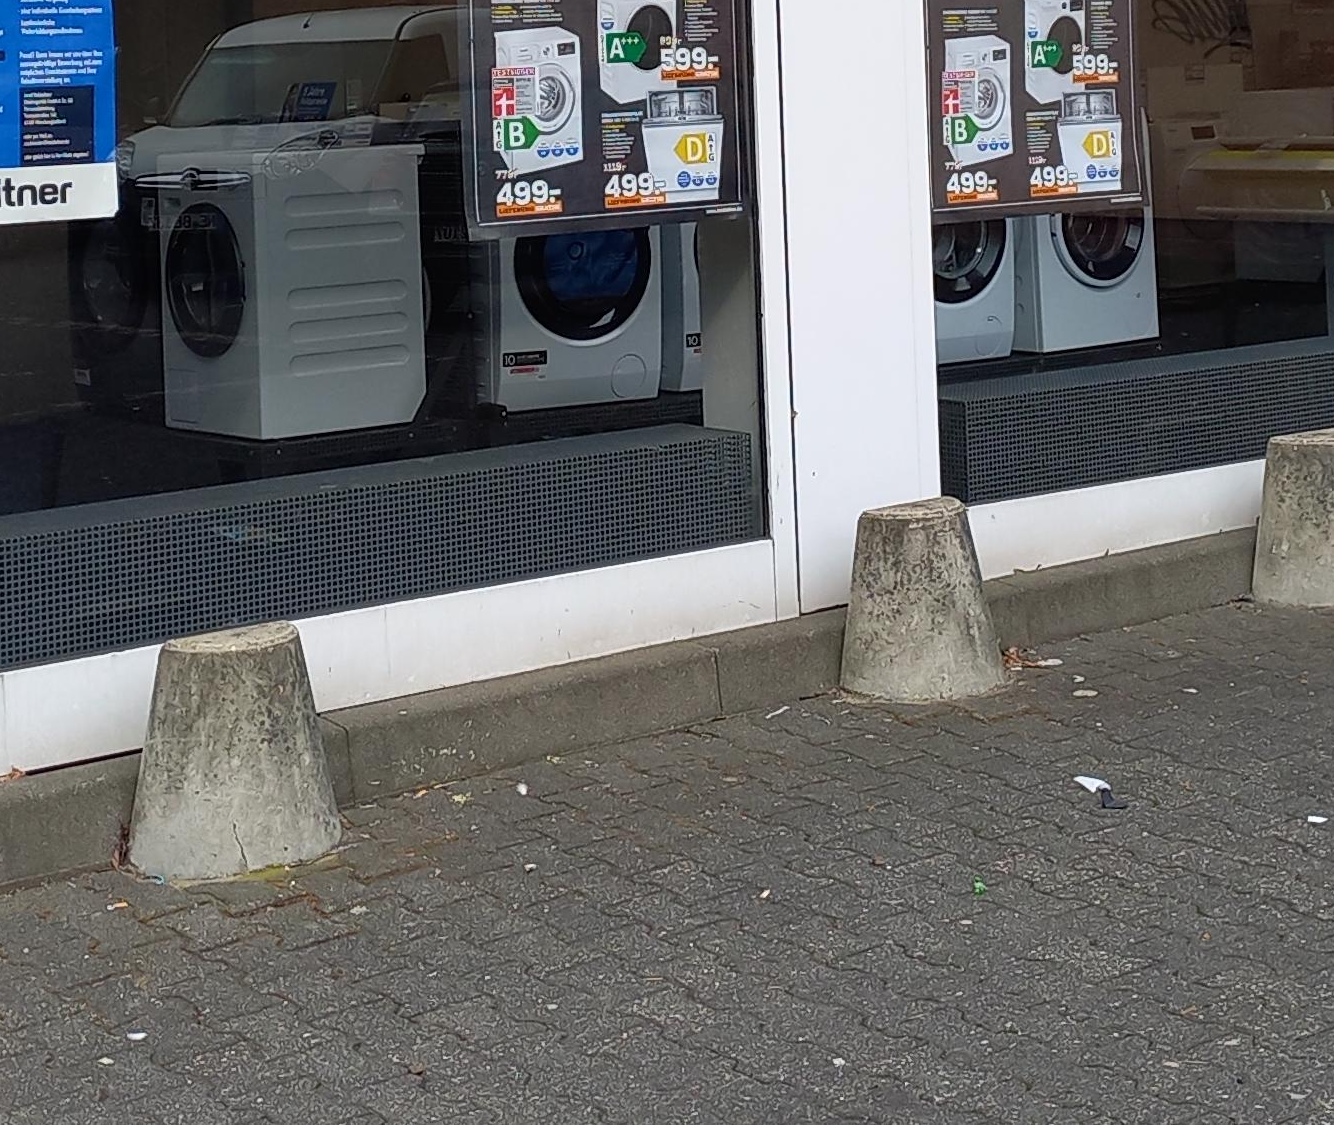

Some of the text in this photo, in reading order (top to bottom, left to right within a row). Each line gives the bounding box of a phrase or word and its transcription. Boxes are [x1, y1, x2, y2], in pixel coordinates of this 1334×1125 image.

[509, 122, 525, 147] B
[954, 120, 967, 142] B
[686, 137, 703, 161] D
[1092, 134, 1106, 156] D
[687, 335, 698, 346] 10
[504, 355, 515, 366] 10
